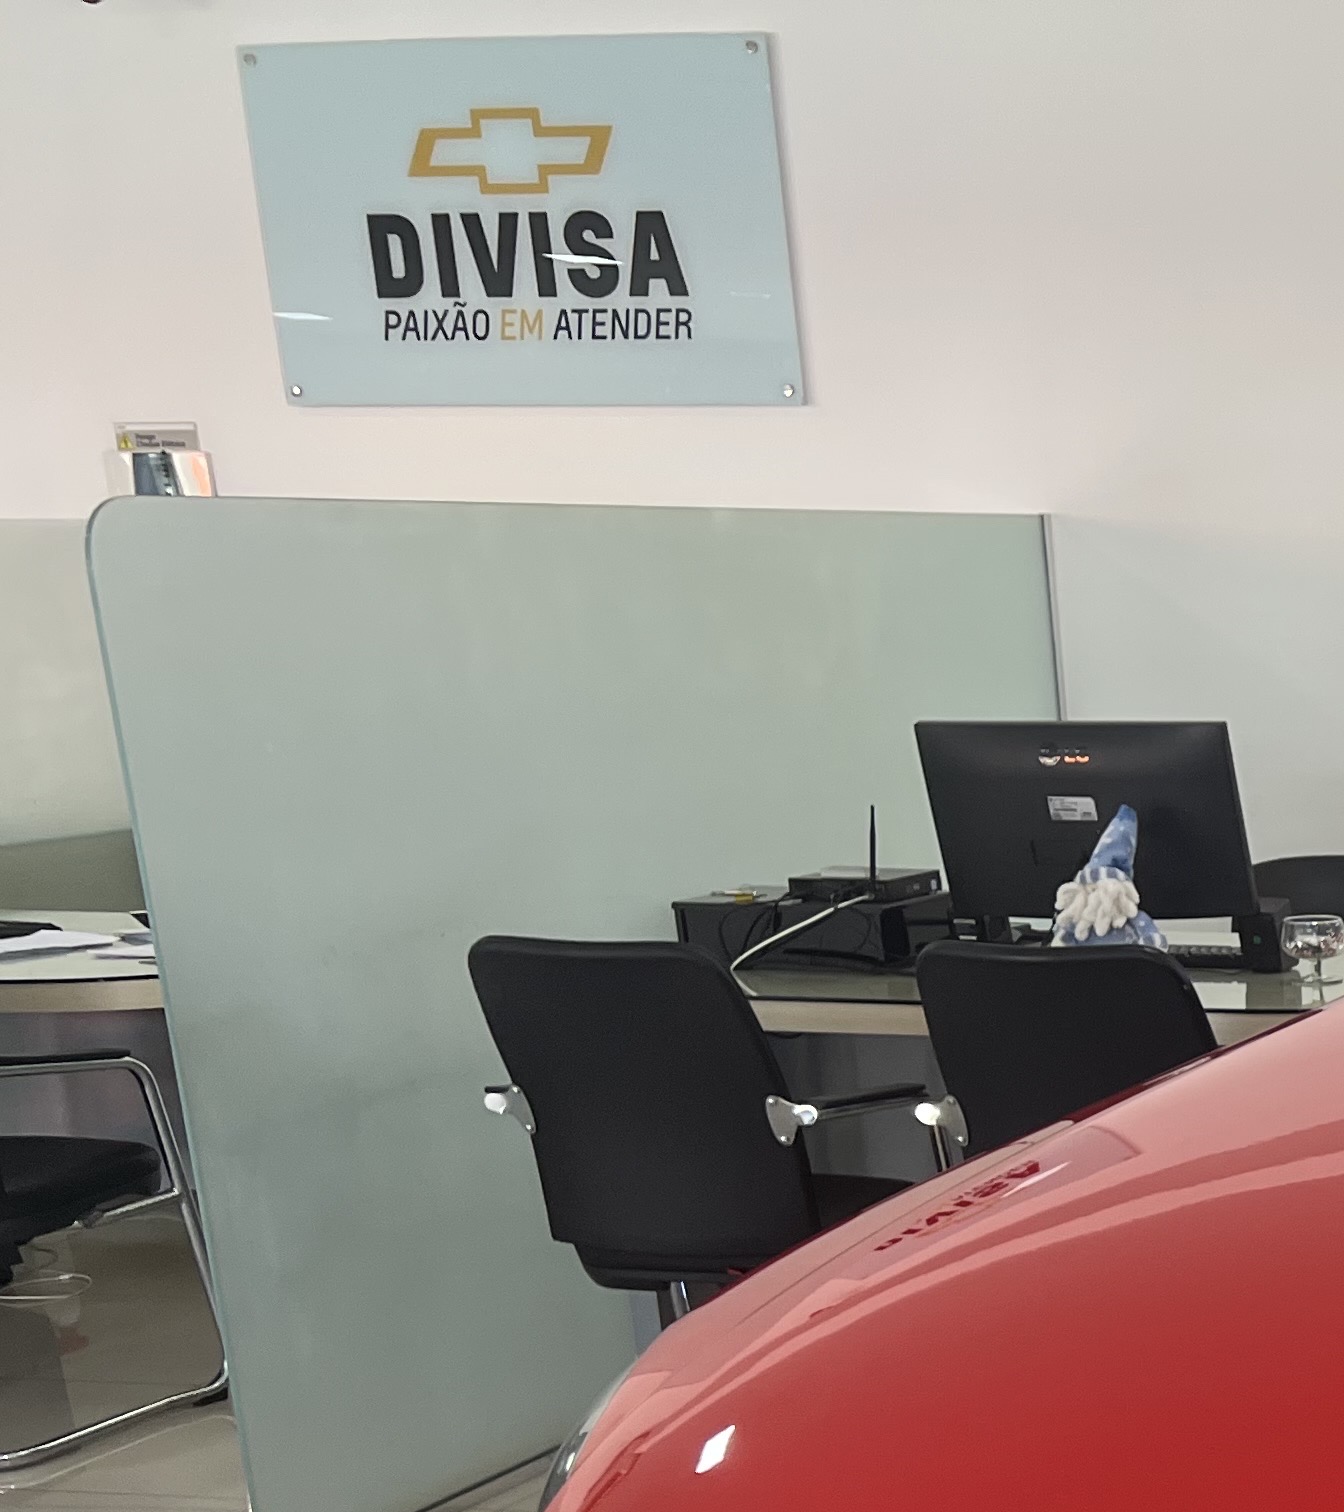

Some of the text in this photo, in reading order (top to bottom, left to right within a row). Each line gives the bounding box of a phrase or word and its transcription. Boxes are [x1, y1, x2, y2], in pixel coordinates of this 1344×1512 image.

[366, 210, 690, 299] DIVISA
[384, 302, 694, 342] PAIXÃO EM ATENDER
